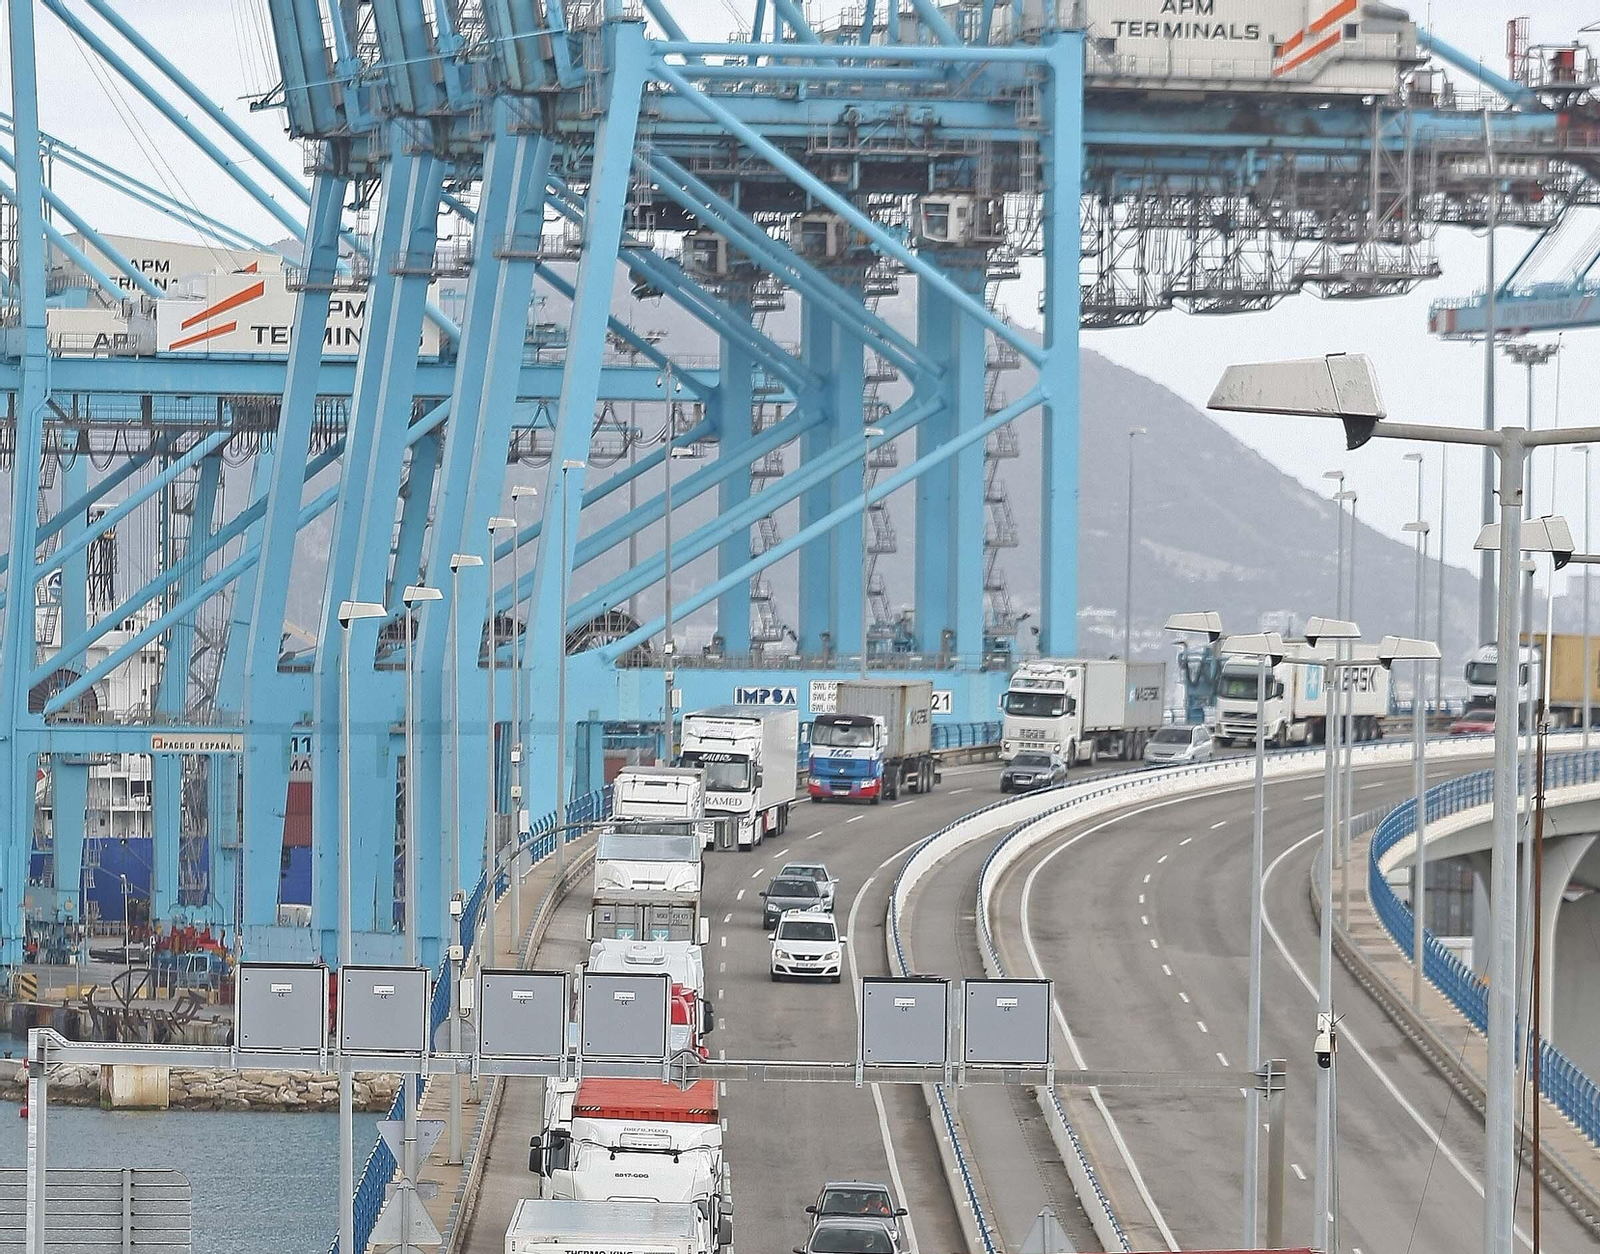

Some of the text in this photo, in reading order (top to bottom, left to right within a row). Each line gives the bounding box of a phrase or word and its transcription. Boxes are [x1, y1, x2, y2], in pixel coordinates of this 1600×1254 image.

[1160, 0, 1214, 16] APM
[1111, 21, 1260, 41] TERMINALS
[736, 688, 796, 705] IMPSA
[931, 693, 950, 711] 21
[199, 740, 232, 750] ESPAÑA
